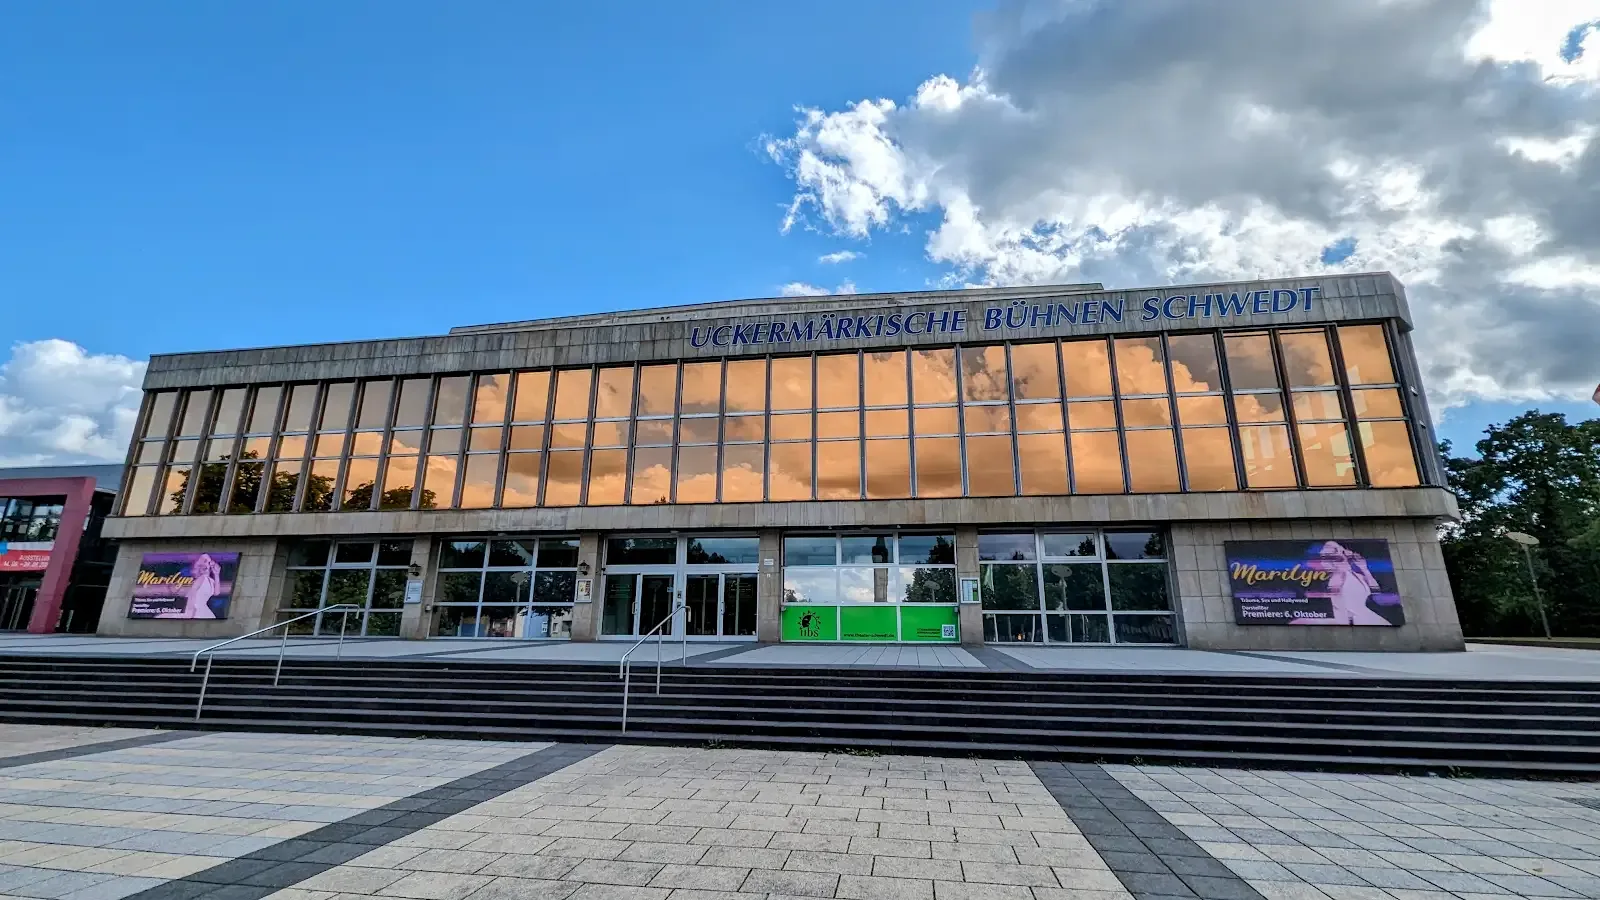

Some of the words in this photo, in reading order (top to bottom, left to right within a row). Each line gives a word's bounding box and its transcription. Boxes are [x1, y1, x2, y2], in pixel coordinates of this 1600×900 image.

[690, 308, 968, 348] UCKERMÄRKISCHE
[983, 298, 1125, 331] BÜHNEN
[1141, 286, 1320, 322] SCHWEDT
[137, 569, 194, 589] Marilyn
[1230, 562, 1330, 587] Marilyn
[1243, 610, 1283, 618] Premiere:
[1284, 610, 1293, 618] 6.
[1294, 610, 1327, 618] Oktober
